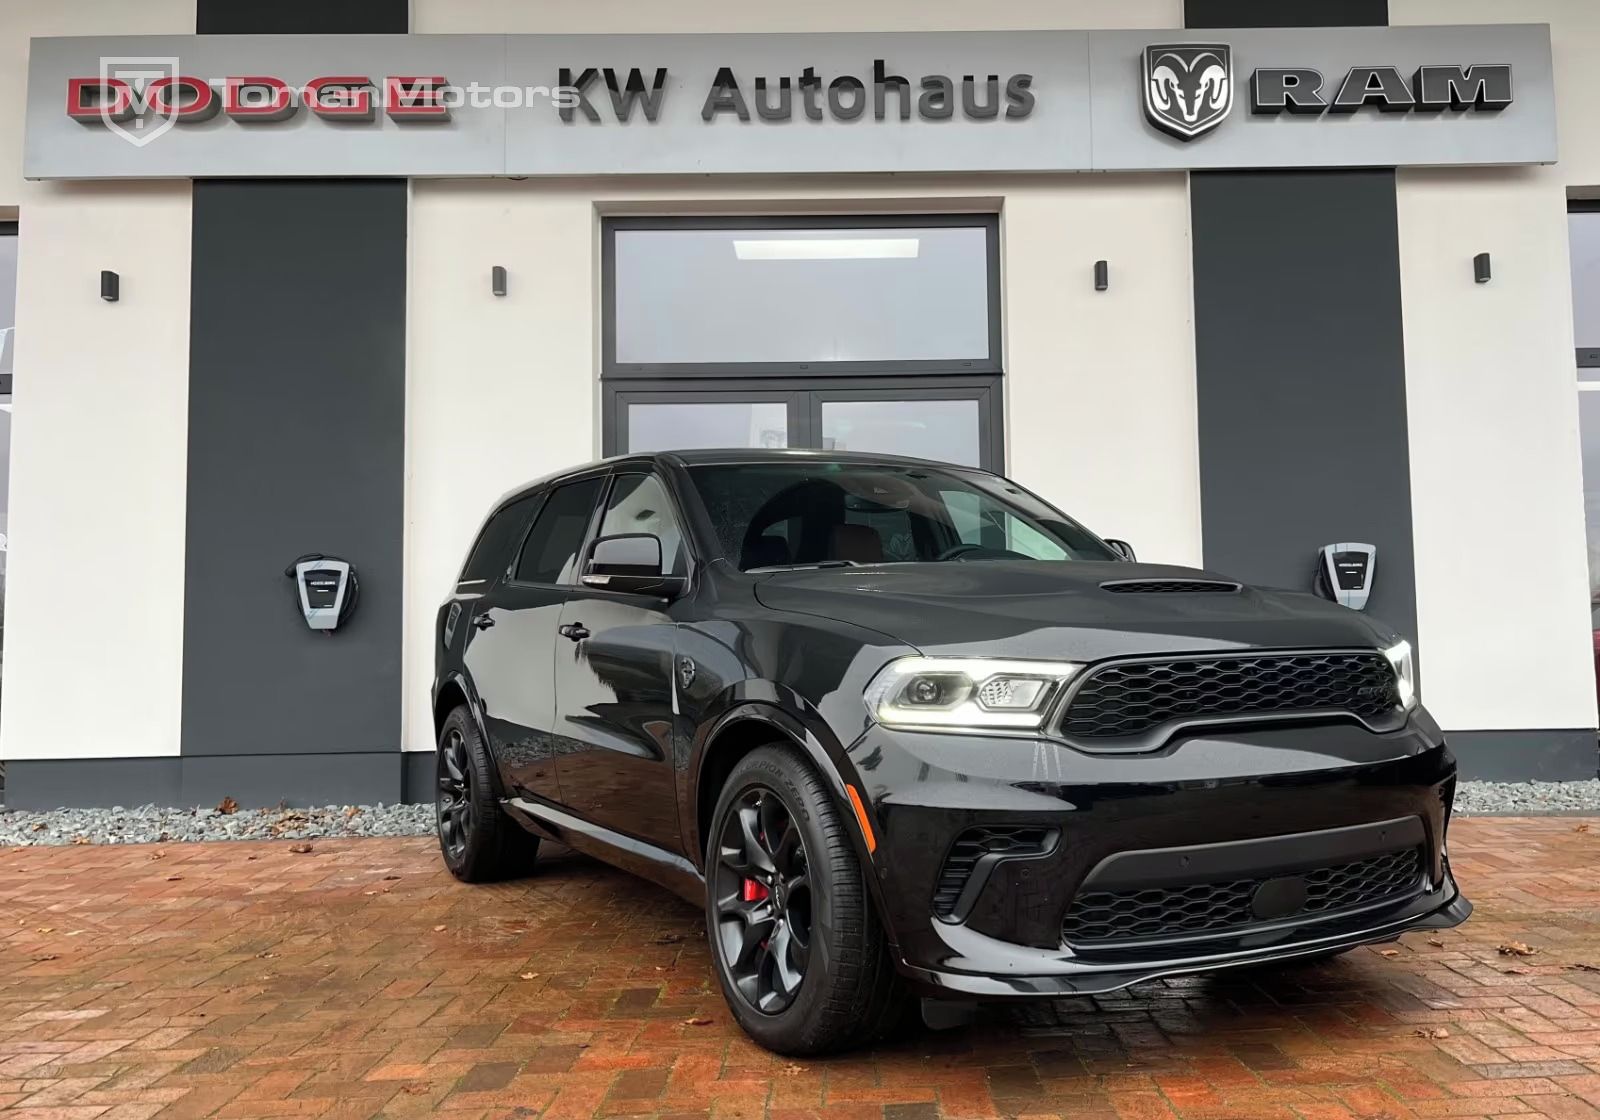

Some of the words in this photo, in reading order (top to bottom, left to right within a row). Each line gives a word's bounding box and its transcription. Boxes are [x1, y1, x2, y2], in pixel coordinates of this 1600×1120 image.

[67, 75, 449, 122] DODGE
[558, 67, 668, 122] KW
[701, 59, 1036, 122] Autohaus
[1252, 63, 1514, 114] RAM
